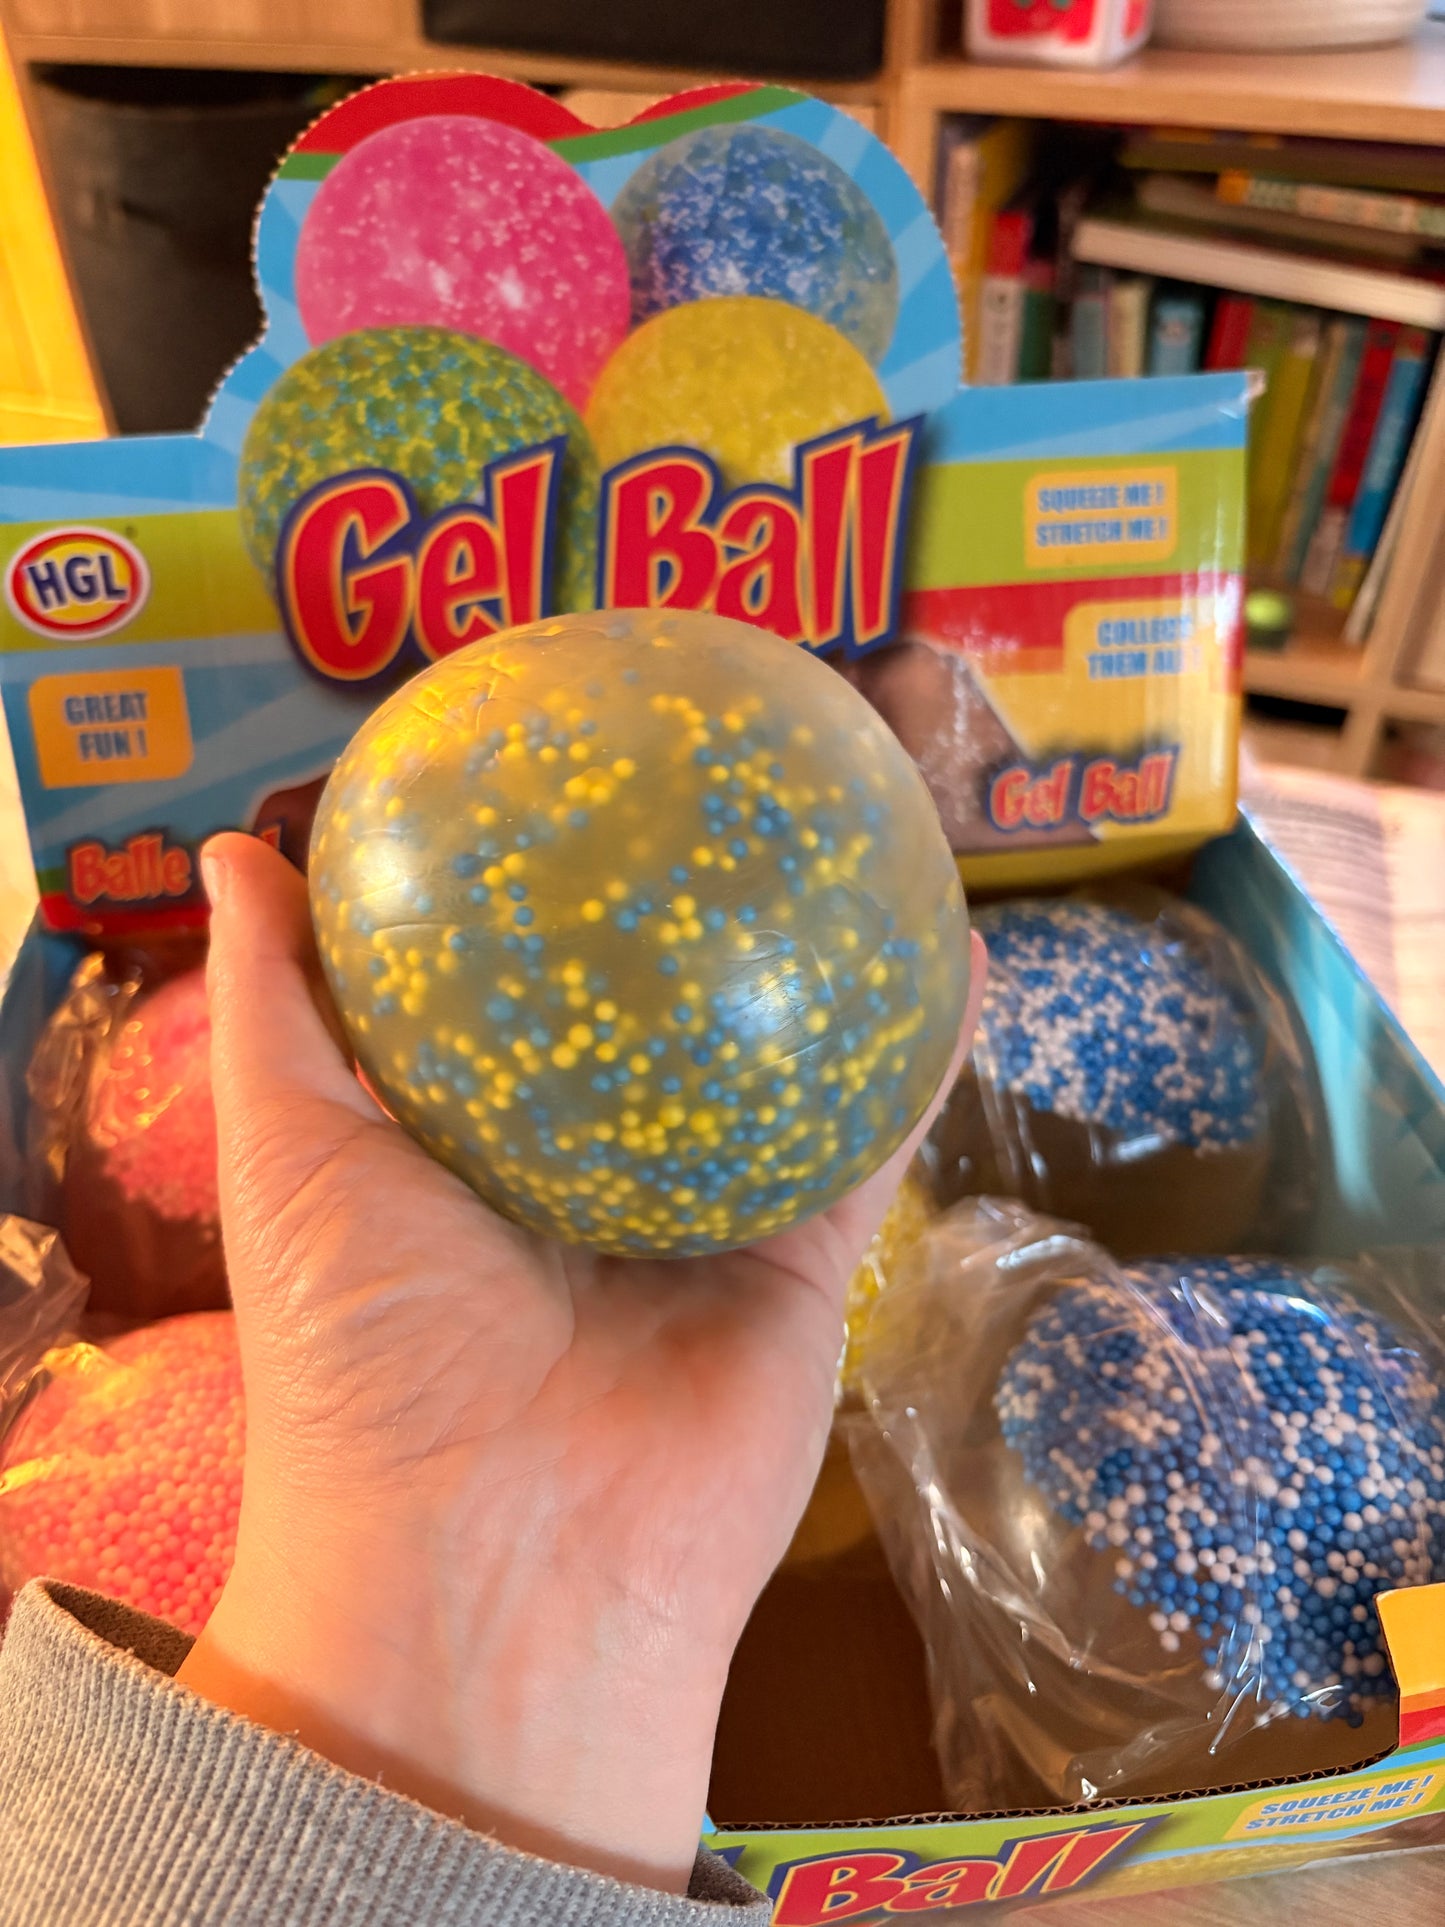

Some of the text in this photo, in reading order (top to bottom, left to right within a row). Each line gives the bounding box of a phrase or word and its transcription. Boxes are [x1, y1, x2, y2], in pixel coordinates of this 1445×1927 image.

[1038, 487, 1119, 513] SQUEEZE
[1125, 484, 1151, 506] ME
[1037, 521, 1122, 546] STRETCH
[1128, 518, 1153, 541] ME
[283, 430, 913, 681] Gel Ball
[27, 555, 127, 610] HGL
[1098, 615, 1192, 647] COLLECT
[1088, 652, 1147, 680] THEM
[65, 693, 146, 726] GREAT
[78, 731, 130, 760] FUN
[990, 754, 1173, 829] Gel Ball
[71, 834, 191, 905] Balle
[1246, 1803, 1365, 1830] STRETCH
[1367, 1796, 1406, 1813] ME
[1261, 1787, 1376, 1815] SQUEEZE
[1377, 1778, 1418, 1796] ME
[770, 1822, 1147, 1927] Ball
